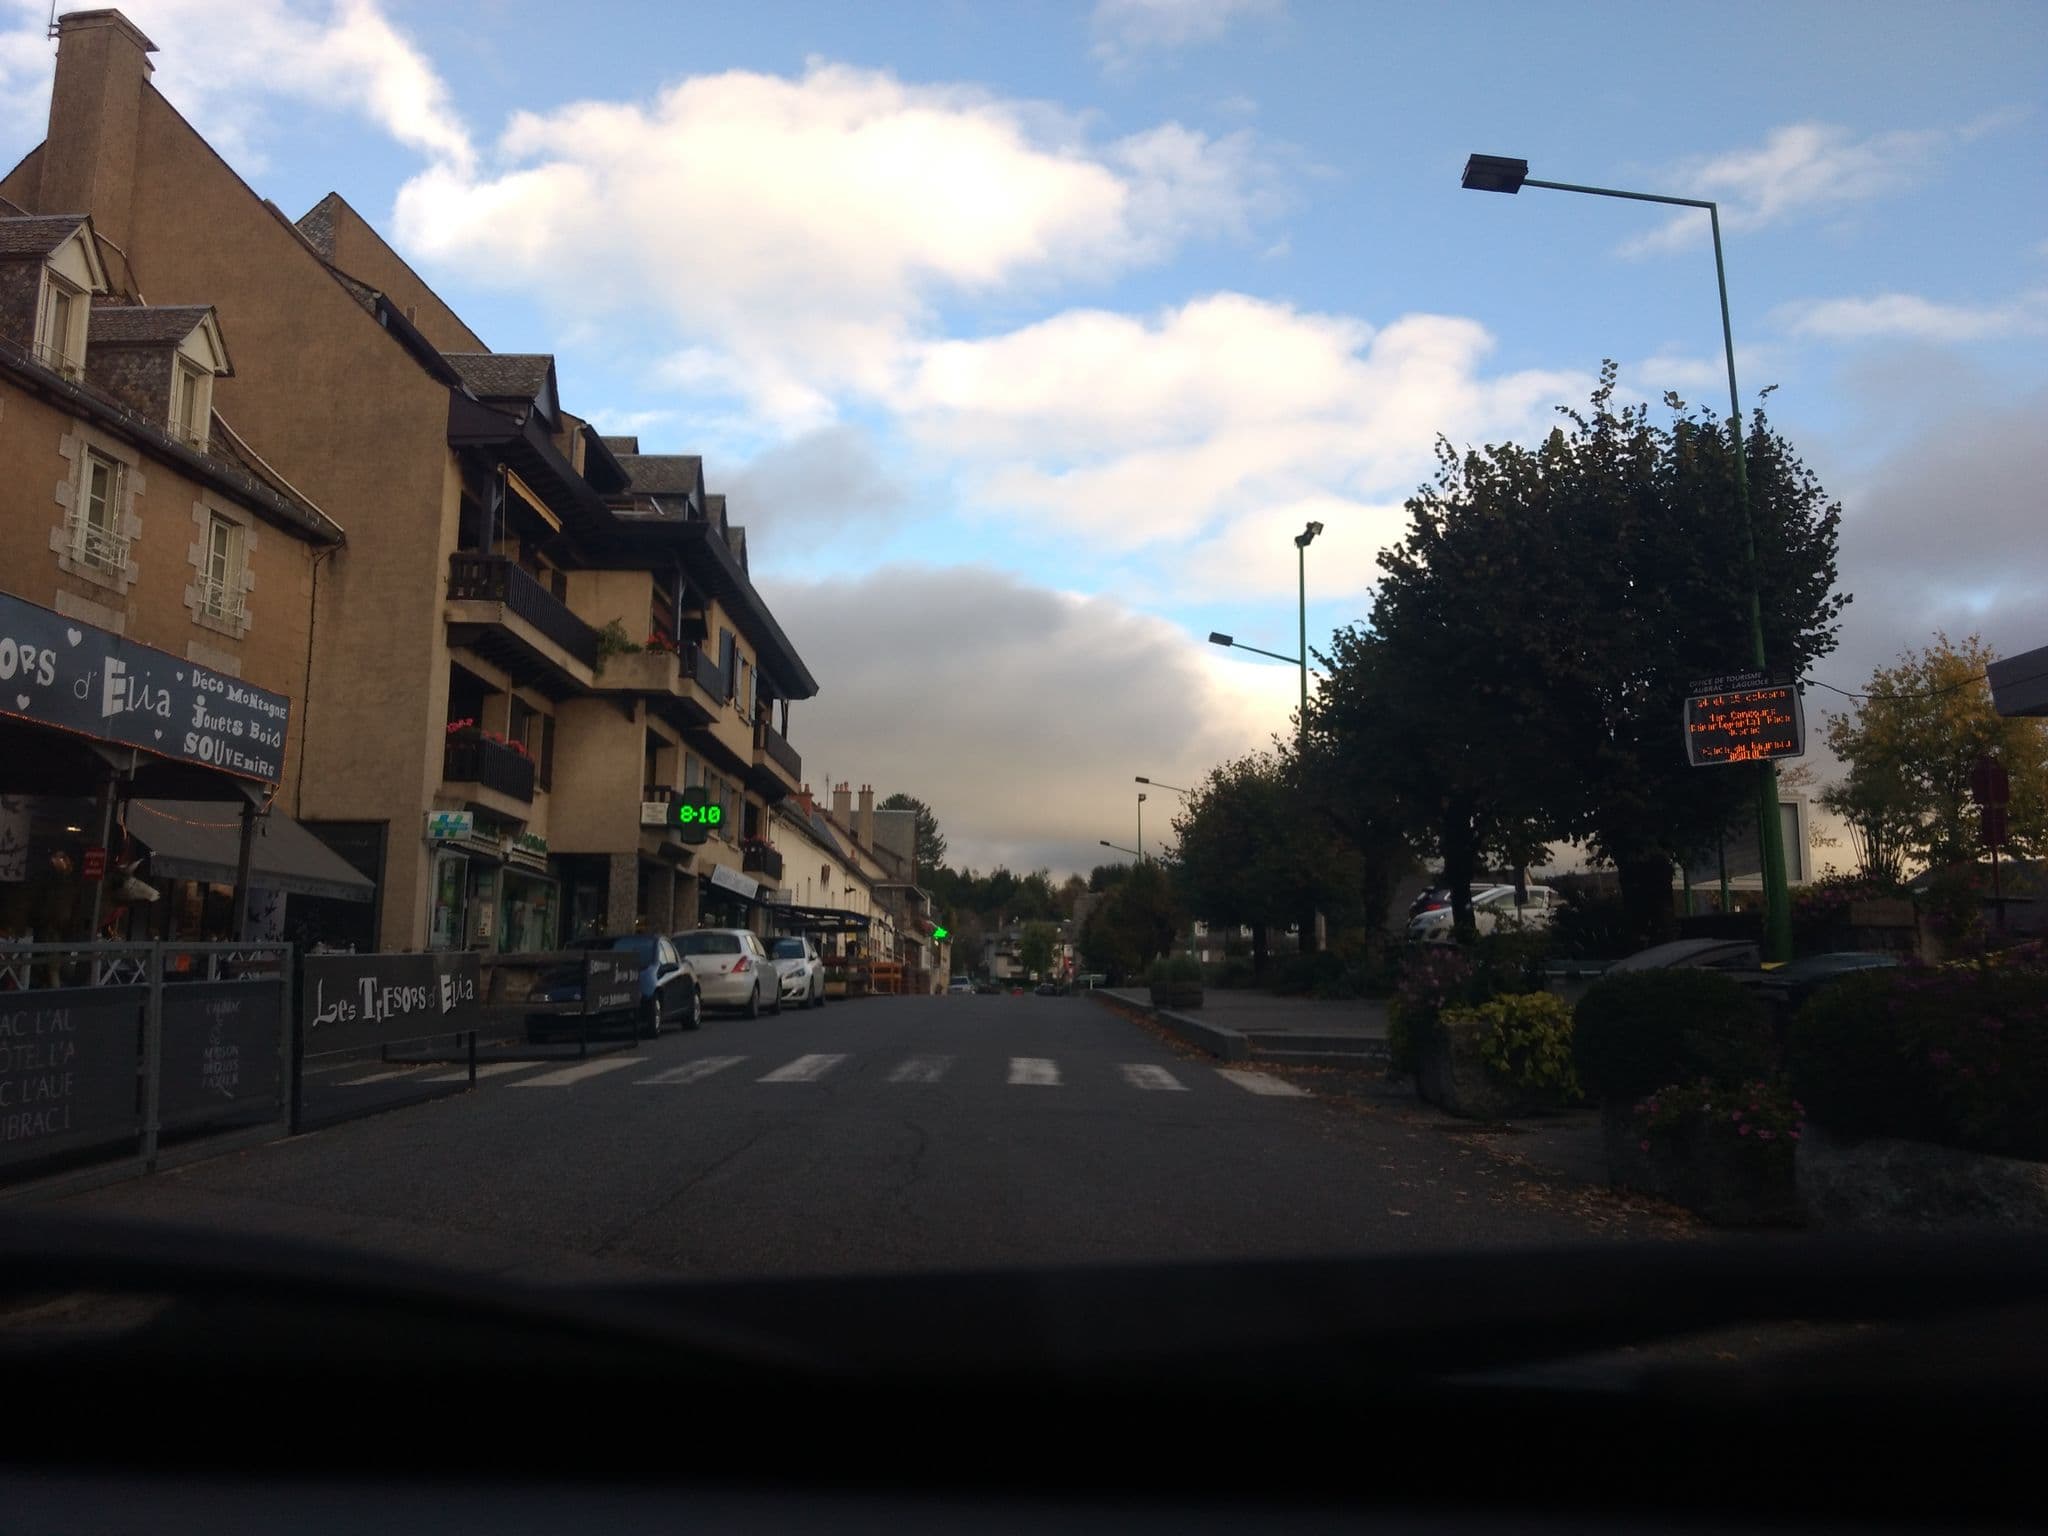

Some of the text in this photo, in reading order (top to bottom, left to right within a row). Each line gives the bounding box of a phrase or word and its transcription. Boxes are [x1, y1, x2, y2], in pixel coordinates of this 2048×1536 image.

[192, 669, 224, 693] Déco
[249, 719, 281, 748] Bois
[312, 977, 358, 1027] Les
